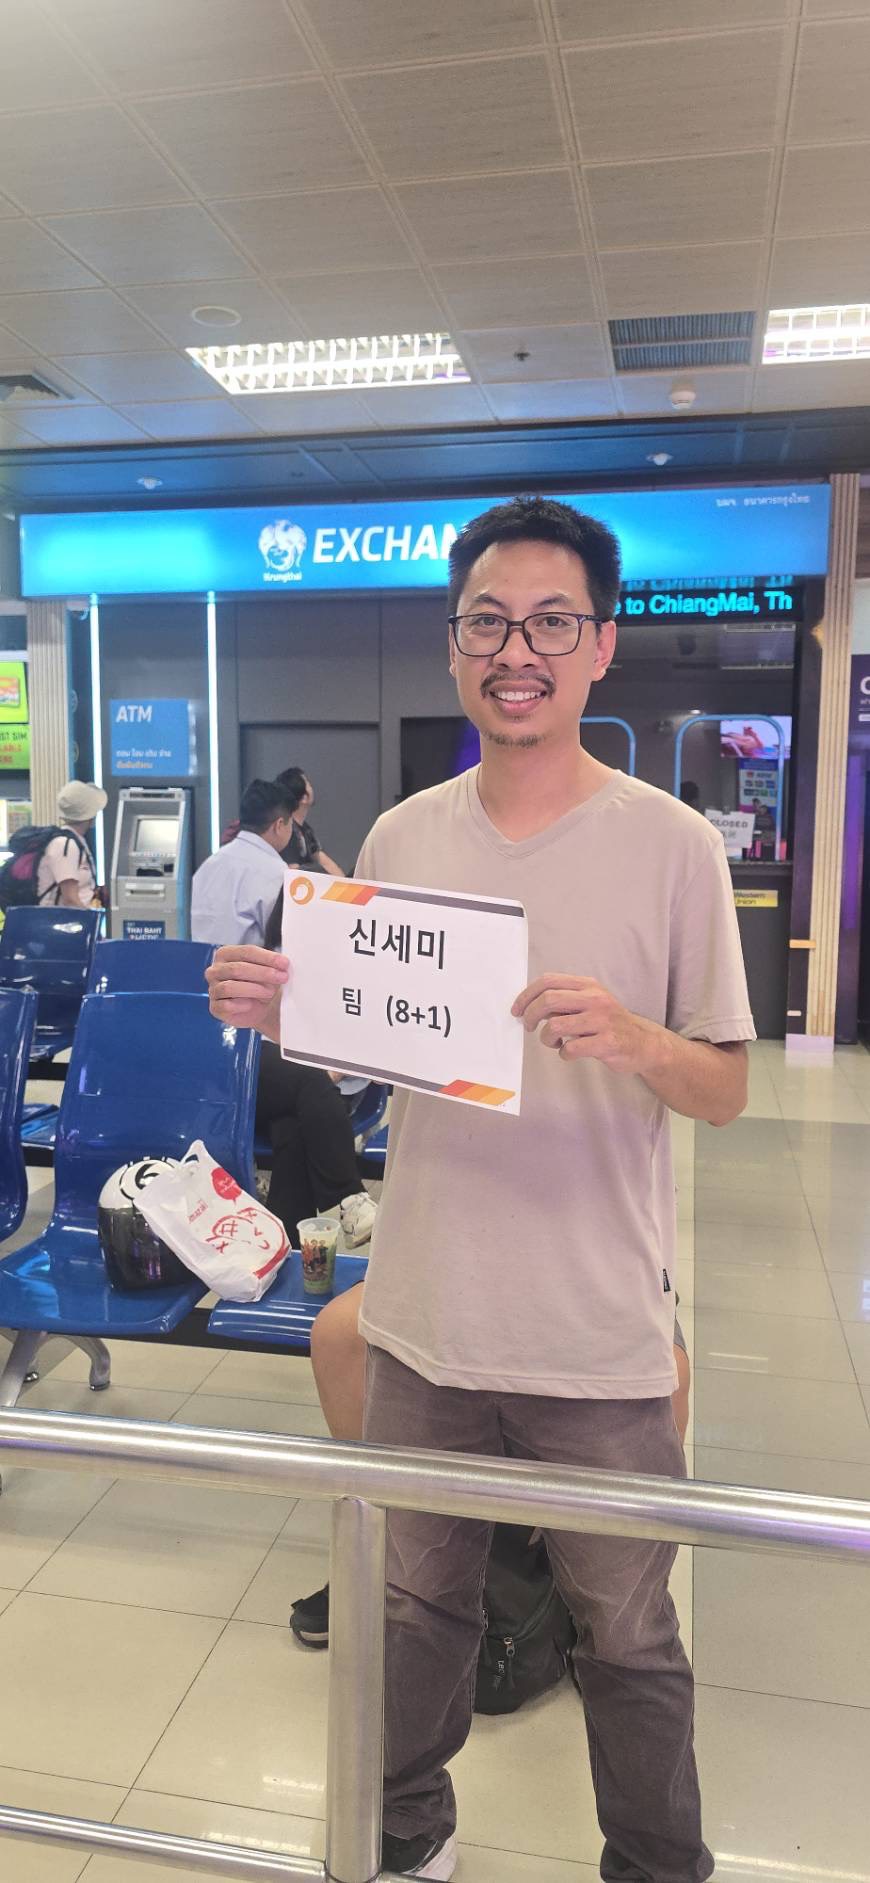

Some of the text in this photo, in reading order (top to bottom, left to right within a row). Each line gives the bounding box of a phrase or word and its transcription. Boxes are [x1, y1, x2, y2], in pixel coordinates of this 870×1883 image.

[625, 597, 645, 615] to
[651, 592, 760, 617] ChiangMai,
[764, 590, 793, 610] Th
[116, 704, 153, 723] ATM
[349, 918, 445, 970] 신세미
[342, 987, 452, 1038] 팀 (8+1)
